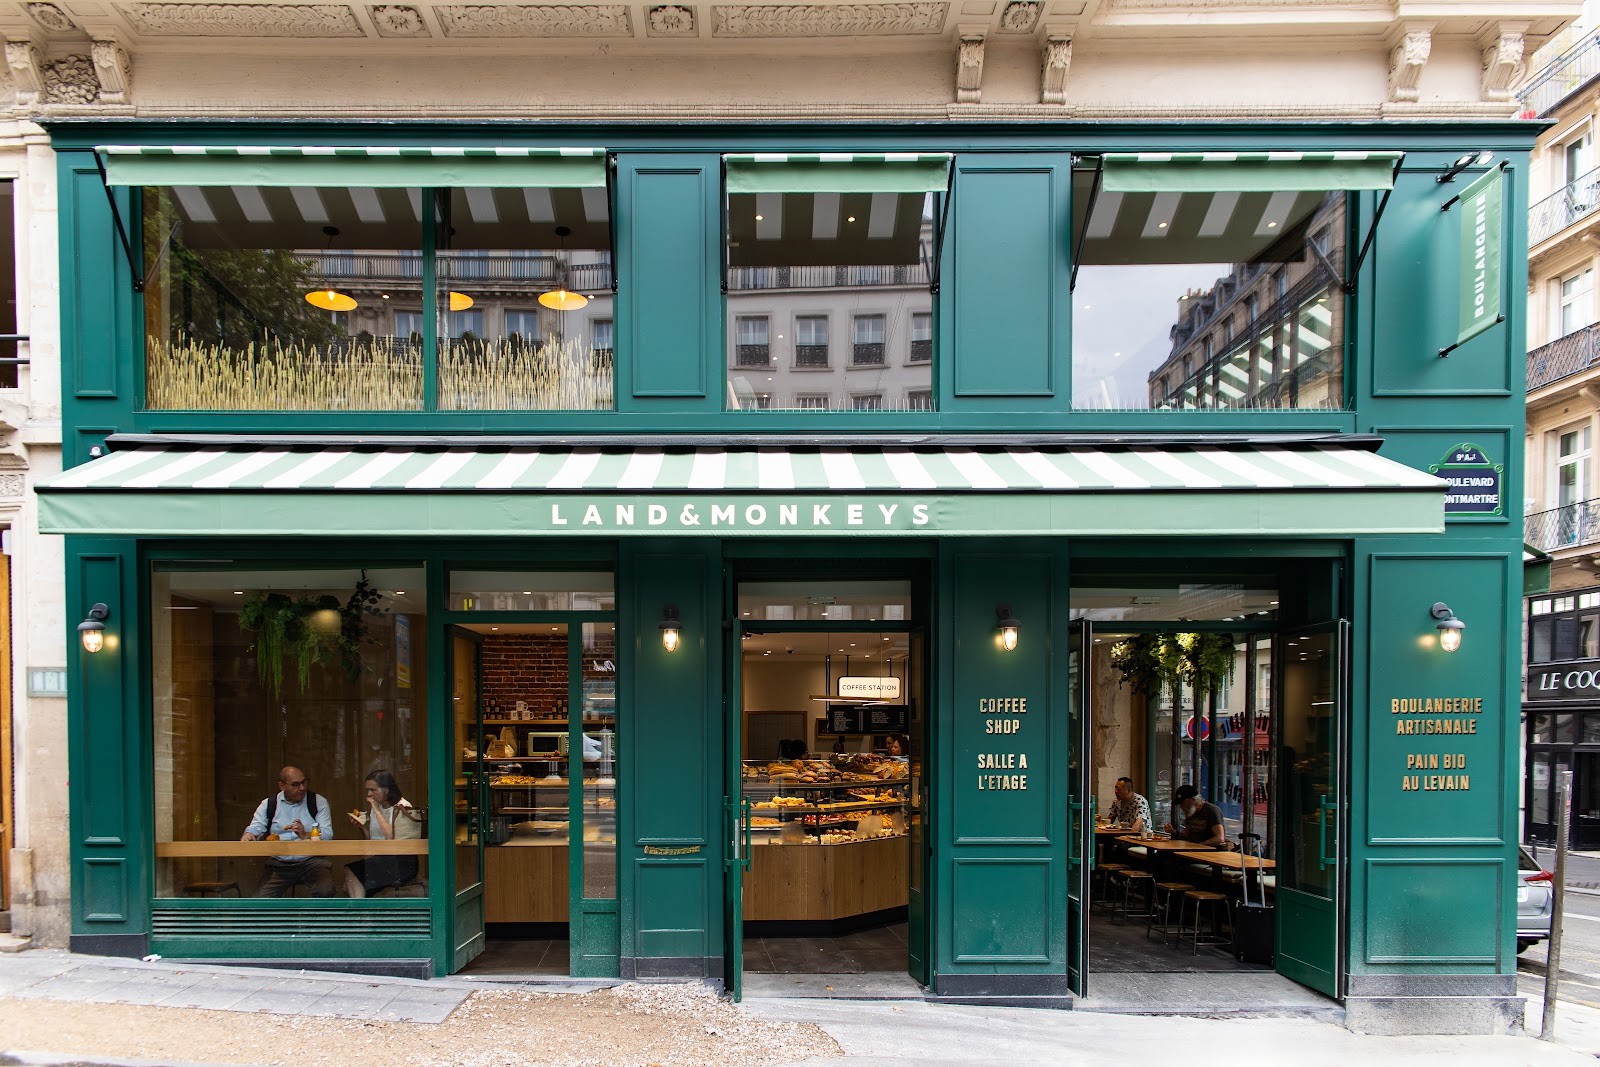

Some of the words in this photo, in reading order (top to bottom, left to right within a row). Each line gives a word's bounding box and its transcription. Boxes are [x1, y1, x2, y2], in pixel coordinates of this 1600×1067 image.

[1474, 193, 1486, 318] BOULANGERIE
[1440, 477, 1494, 487] OULEVARD
[1539, 672, 1561, 691] LE
[979, 697, 1027, 714] COFFEE
[1391, 697, 1483, 714] BOULANGERIE
[985, 719, 1020, 735] SHOP
[1396, 719, 1477, 735] ARTISANALE
[977, 753, 1015, 769] SALLE
[1018, 753, 1028, 769] A
[1407, 753, 1439, 770] PAIN
[1443, 753, 1466, 770] BIO
[978, 774, 1028, 790] L'ETAGE
[1402, 775, 1420, 791] AU
[1424, 774, 1470, 791] LEVAIN
